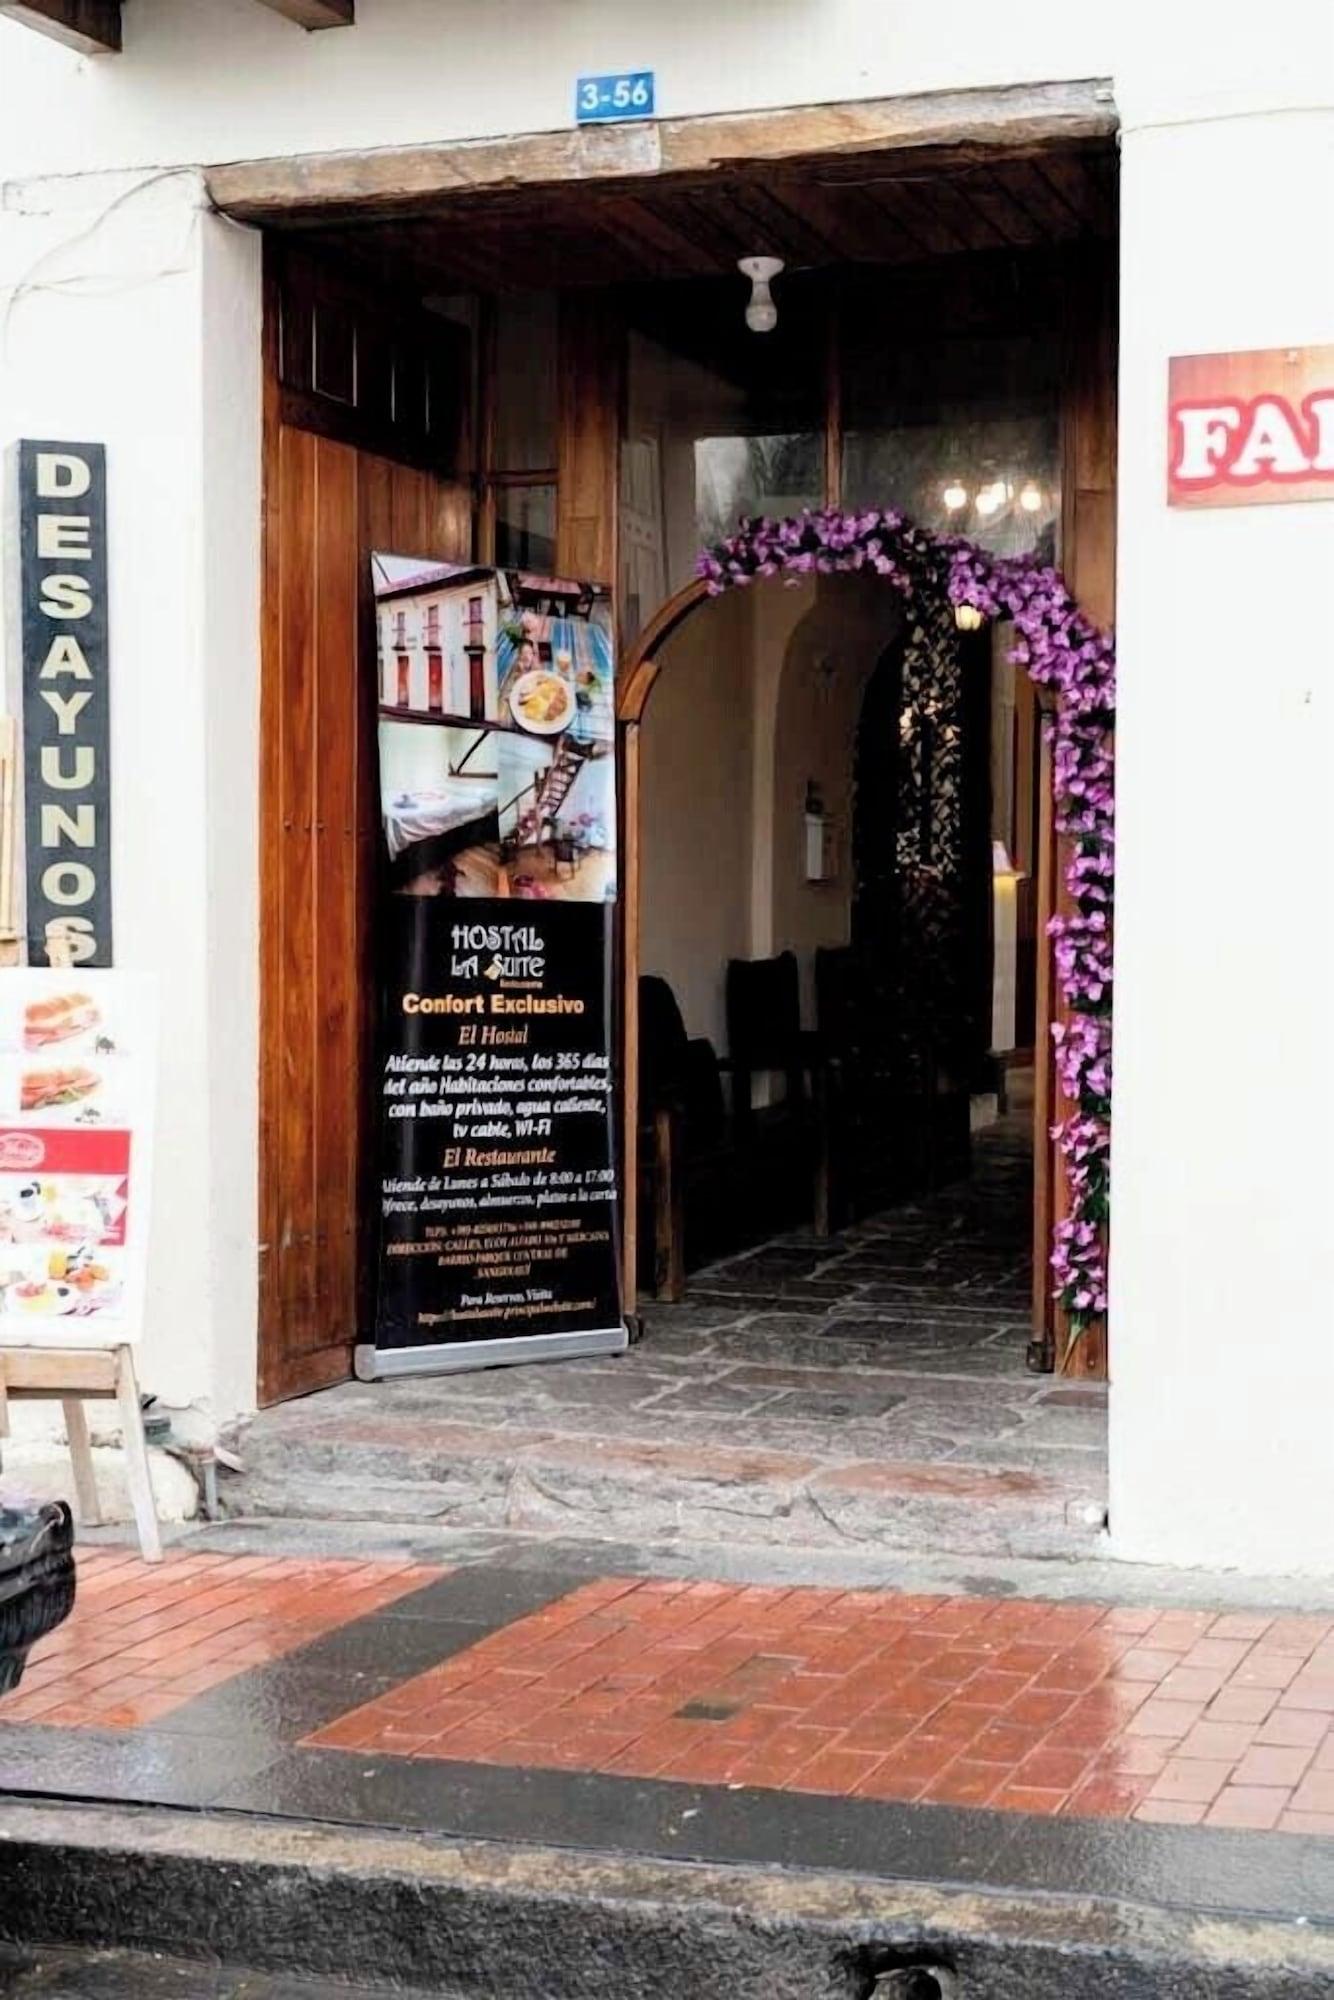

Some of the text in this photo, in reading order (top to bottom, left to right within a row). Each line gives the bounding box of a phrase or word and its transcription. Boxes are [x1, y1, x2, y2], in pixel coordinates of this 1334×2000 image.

[581, 79, 648, 110] 3-56
[36, 453, 97, 963] DESAYUNOS
[451, 924, 545, 953] HOSTAL
[451, 955, 479, 979] LA
[402, 992, 585, 1014] Confort Exclusivo
[458, 1023, 529, 1045] El Hostal
[385, 1054, 441, 1072] Atiende
[442, 1054, 463, 1071] las
[465, 1052, 487, 1072] 24
[531, 1052, 554, 1070] los
[555, 1052, 580, 1069] 365
[388, 1103, 416, 1118] con
[443, 1146, 557, 1168] El Restaurante
